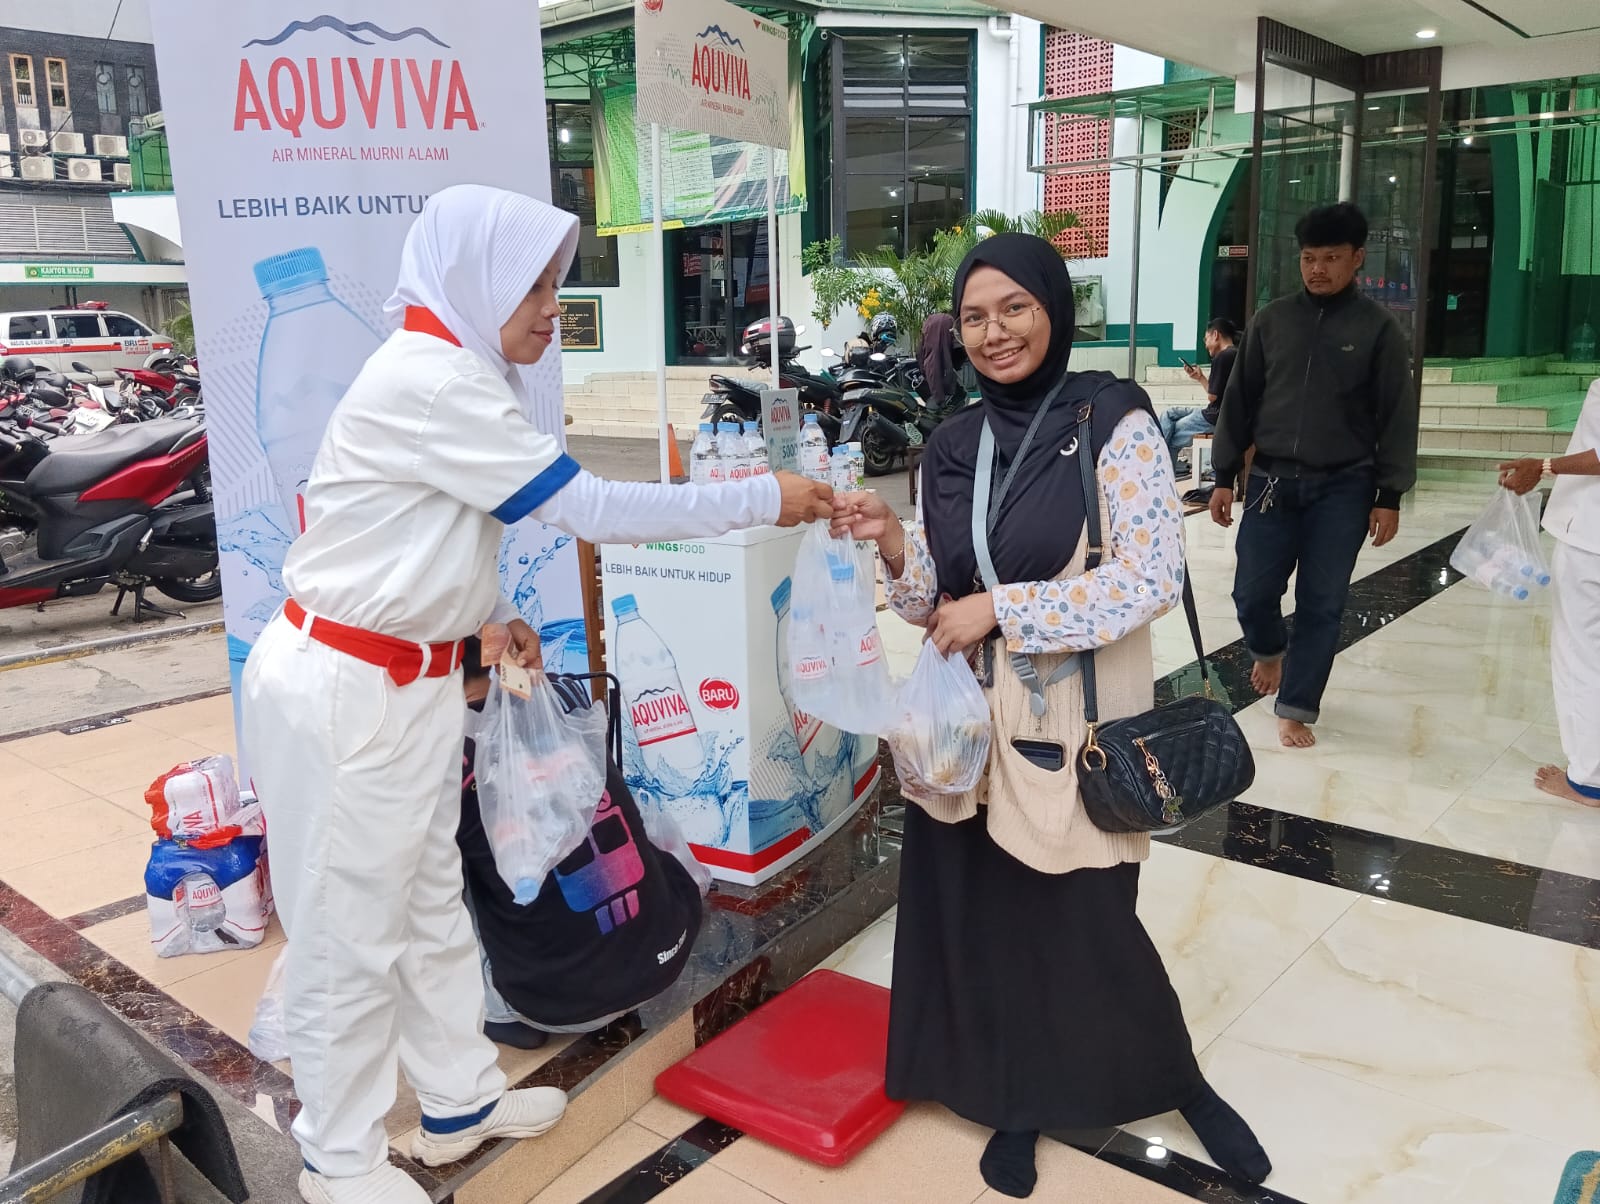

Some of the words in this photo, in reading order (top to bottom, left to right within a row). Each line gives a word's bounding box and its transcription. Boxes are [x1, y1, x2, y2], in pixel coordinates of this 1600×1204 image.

[692, 43, 751, 101] AQUVIVA
[234, 57, 479, 138] AQUVIVA
[272, 147, 294, 162] AIR
[297, 146, 357, 161] MINERAL
[360, 146, 404, 161] MURNI
[408, 147, 449, 161] ALAMI
[218, 197, 288, 219] LEBIH
[295, 195, 352, 216] BAIK
[358, 195, 430, 215] UNTU
[771, 404, 792, 424] AQUVIVA
[645, 541, 706, 554] WINGSFOOD
[605, 562, 633, 575] LEBIH
[635, 565, 658, 577] BAIK
[660, 567, 696, 581] UNTUK
[698, 571, 732, 584] HIDUP
[702, 688, 734, 702] BARU
[632, 693, 689, 727] AQUVIVA
